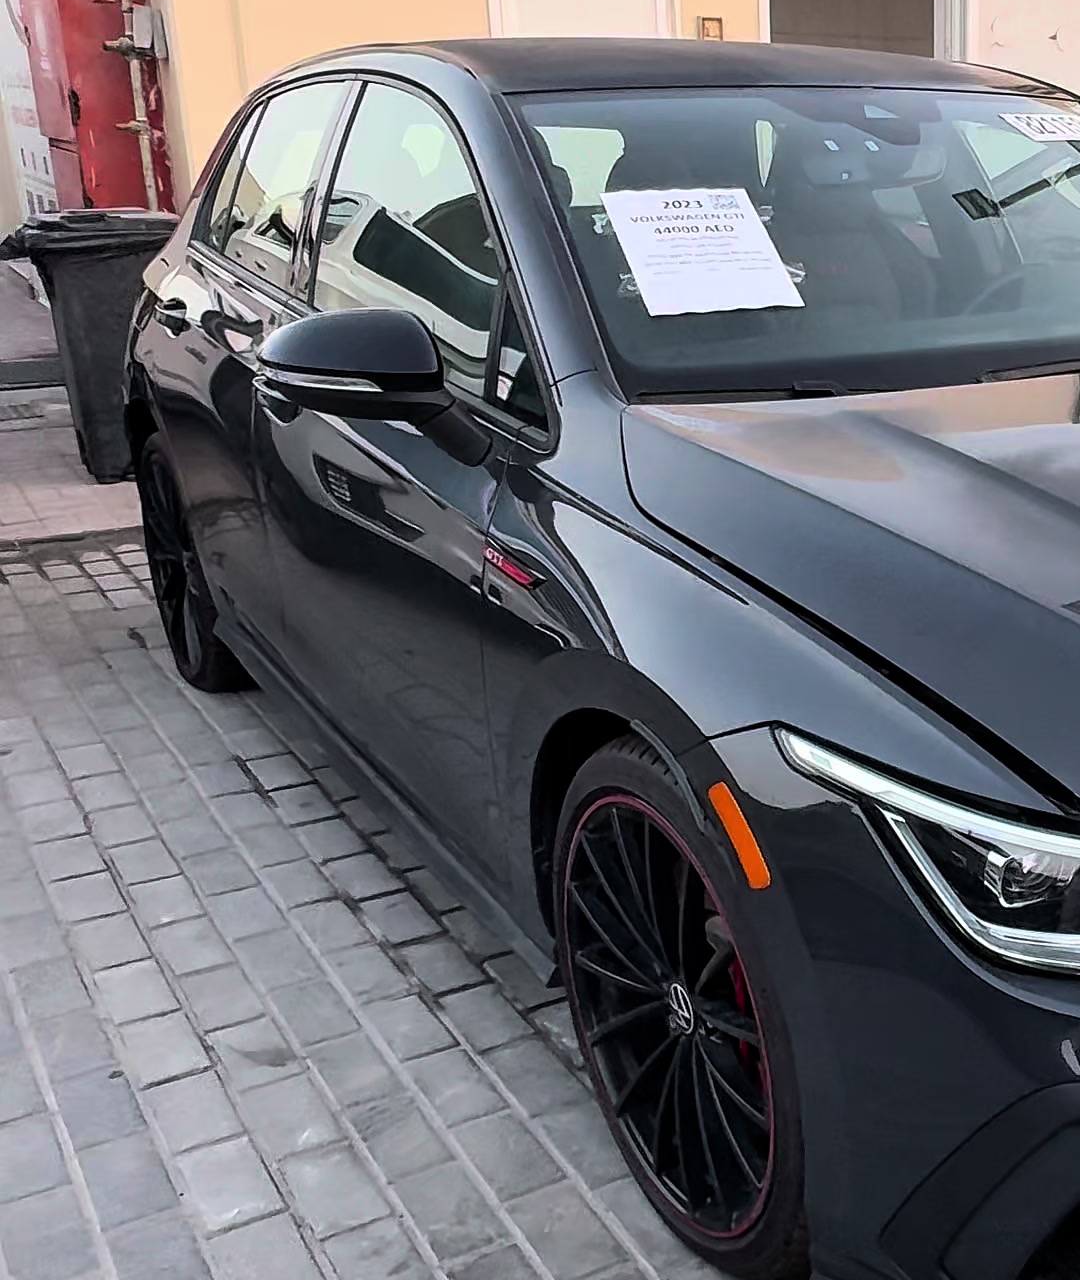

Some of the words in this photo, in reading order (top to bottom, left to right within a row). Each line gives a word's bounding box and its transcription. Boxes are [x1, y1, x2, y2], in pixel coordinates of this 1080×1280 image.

[661, 200, 703, 209] 2023
[630, 213, 720, 223] VOLKSWAGEN
[654, 225, 700, 235] 44000
[705, 224, 734, 233] AED
[486, 547, 504, 566] GTI
